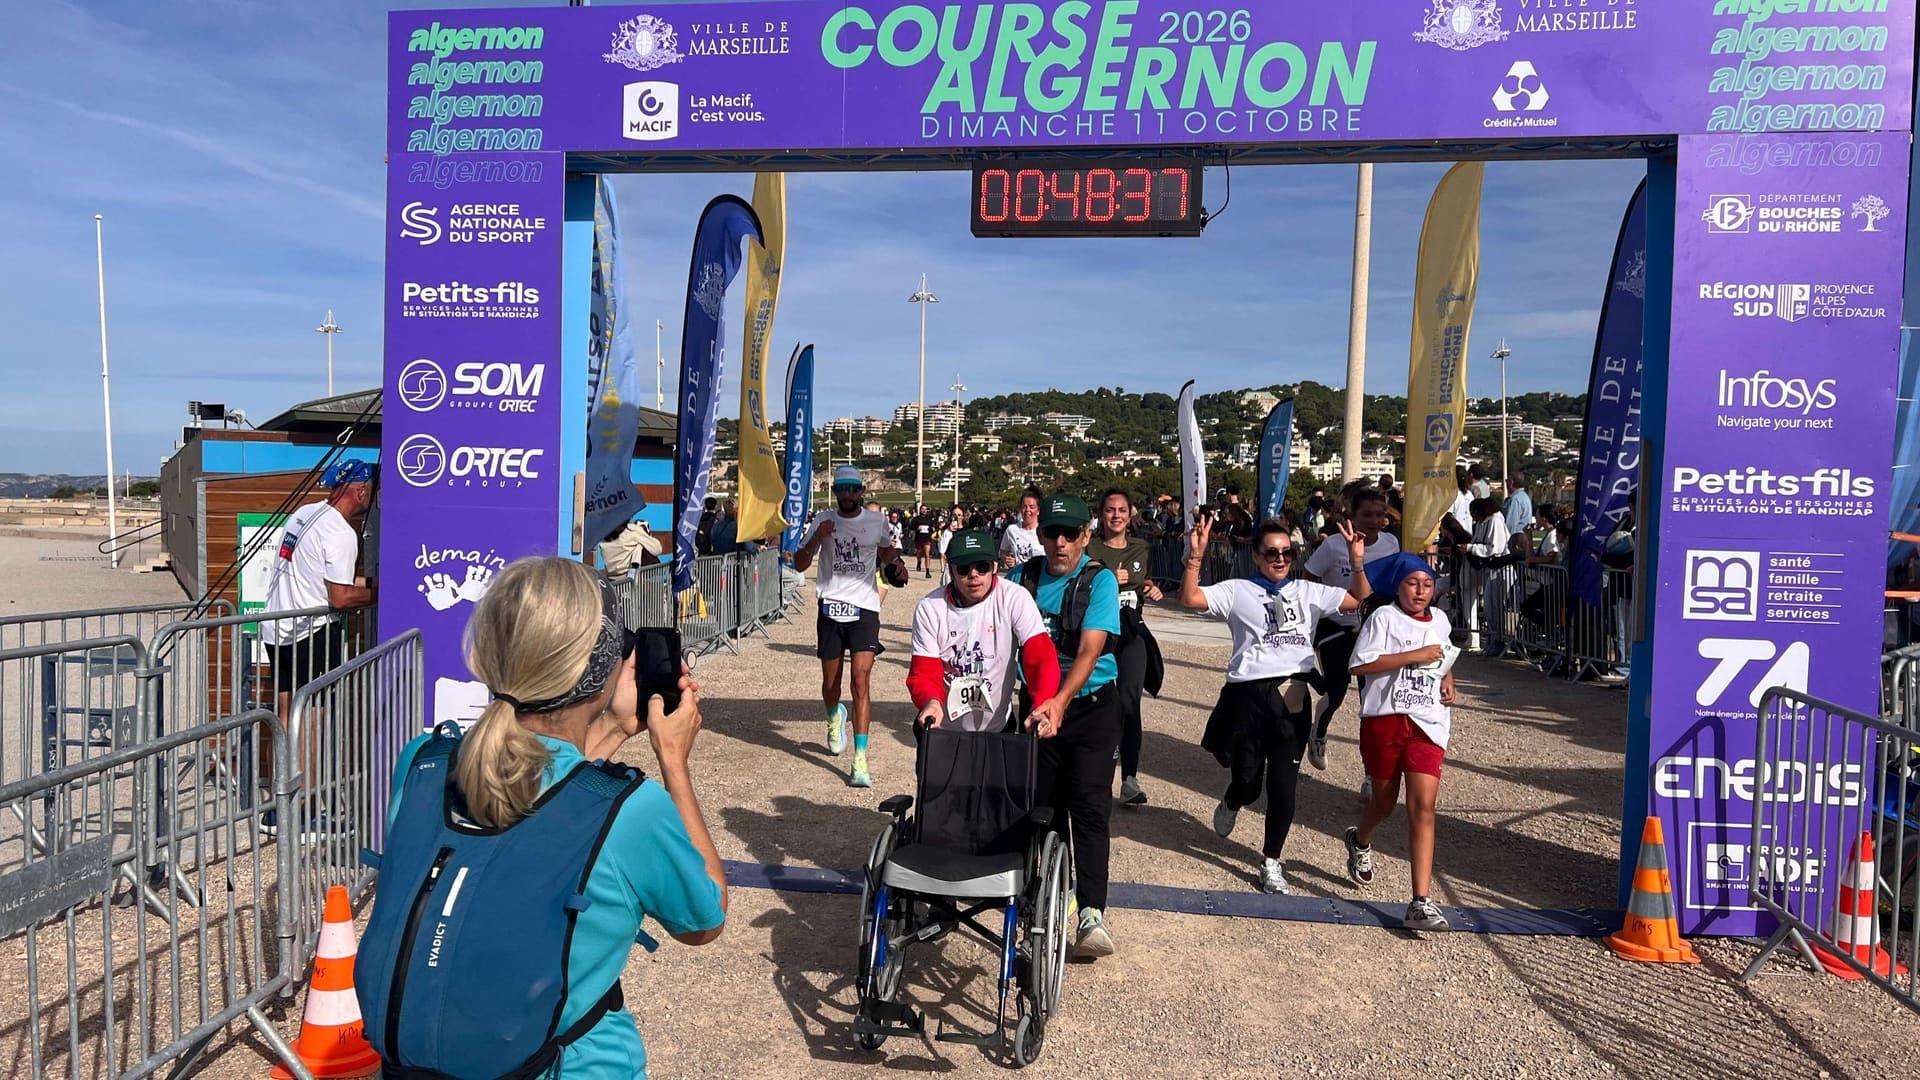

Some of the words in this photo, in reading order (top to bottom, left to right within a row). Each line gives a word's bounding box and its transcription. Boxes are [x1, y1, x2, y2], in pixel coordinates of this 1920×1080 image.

[691, 23, 749, 34] VILLE
[764, 21, 788, 33] DE
[1158, 9, 1252, 44] 2026
[1515, 10, 1636, 32] MARSEILLE
[408, 22, 544, 58] algernon
[821, 0, 1139, 68] COURSE
[1711, 20, 1888, 60] algernon
[688, 36, 790, 56] MARSEILLE
[408, 55, 544, 92] algernon
[920, 40, 1377, 113] ALGERNON
[1709, 58, 1886, 100] algernon
[408, 89, 543, 124] algernon
[690, 95, 707, 108] La
[710, 93, 754, 110] Macif,
[690, 108, 724, 123] c'est
[727, 109, 765, 122] vous.
[922, 114, 1114, 138] DIMANCHE
[1134, 112, 1165, 135] 11
[1184, 109, 1361, 135] OCTOBRE
[1483, 118, 1512, 127] Crédit
[1524, 117, 1557, 127] Mutuel
[1707, 96, 1884, 133] algernon
[629, 120, 672, 133] MACIF
[408, 122, 543, 156] algernon
[1706, 135, 1881, 175] algernon
[408, 154, 543, 190] algernon
[980, 168, 1188, 222] 00:48:37
[450, 204, 519, 216] AGENCE
[450, 217, 545, 230] NATIONALE
[450, 231, 474, 243] DU
[477, 230, 535, 243] SPORT
[1700, 282, 1774, 299] RÉGION
[1814, 285, 1875, 295] PROVENCE
[1733, 302, 1774, 316] SUD
[1813, 296, 1846, 305] ALPES
[1813, 306, 1843, 317] CÔTE
[452, 363, 545, 396] SOM
[687, 367, 700, 415] DE
[1718, 369, 1837, 415] Infosys
[450, 401, 493, 409] GROUPE
[499, 399, 537, 412] ORTEC
[1717, 415, 1771, 430] Navigate
[1774, 417, 1801, 430] your
[1805, 418, 1833, 429] next
[1581, 424, 1615, 537] VILLE
[1600, 356, 1627, 403] DE
[449, 446, 544, 479] ORTEC
[448, 480, 522, 488] GROUP
[1672, 504, 1690, 512] EN
[1695, 505, 1769, 514] SITUATION
[1774, 506, 1793, 514] DE
[1798, 507, 1873, 516] HANDICAP
[1673, 497, 1742, 505] SERVICES
[1786, 500, 1873, 508] PERSONNES
[415, 543, 505, 569] demain
[1770, 556, 1811, 568] santé
[1768, 573, 1819, 585] famille
[1768, 591, 1823, 602] retraite
[1767, 607, 1830, 619] services
[1695, 709, 1715, 717] Notre
[1716, 710, 1744, 720] énergie
[428, 922, 446, 967] EVADICT
